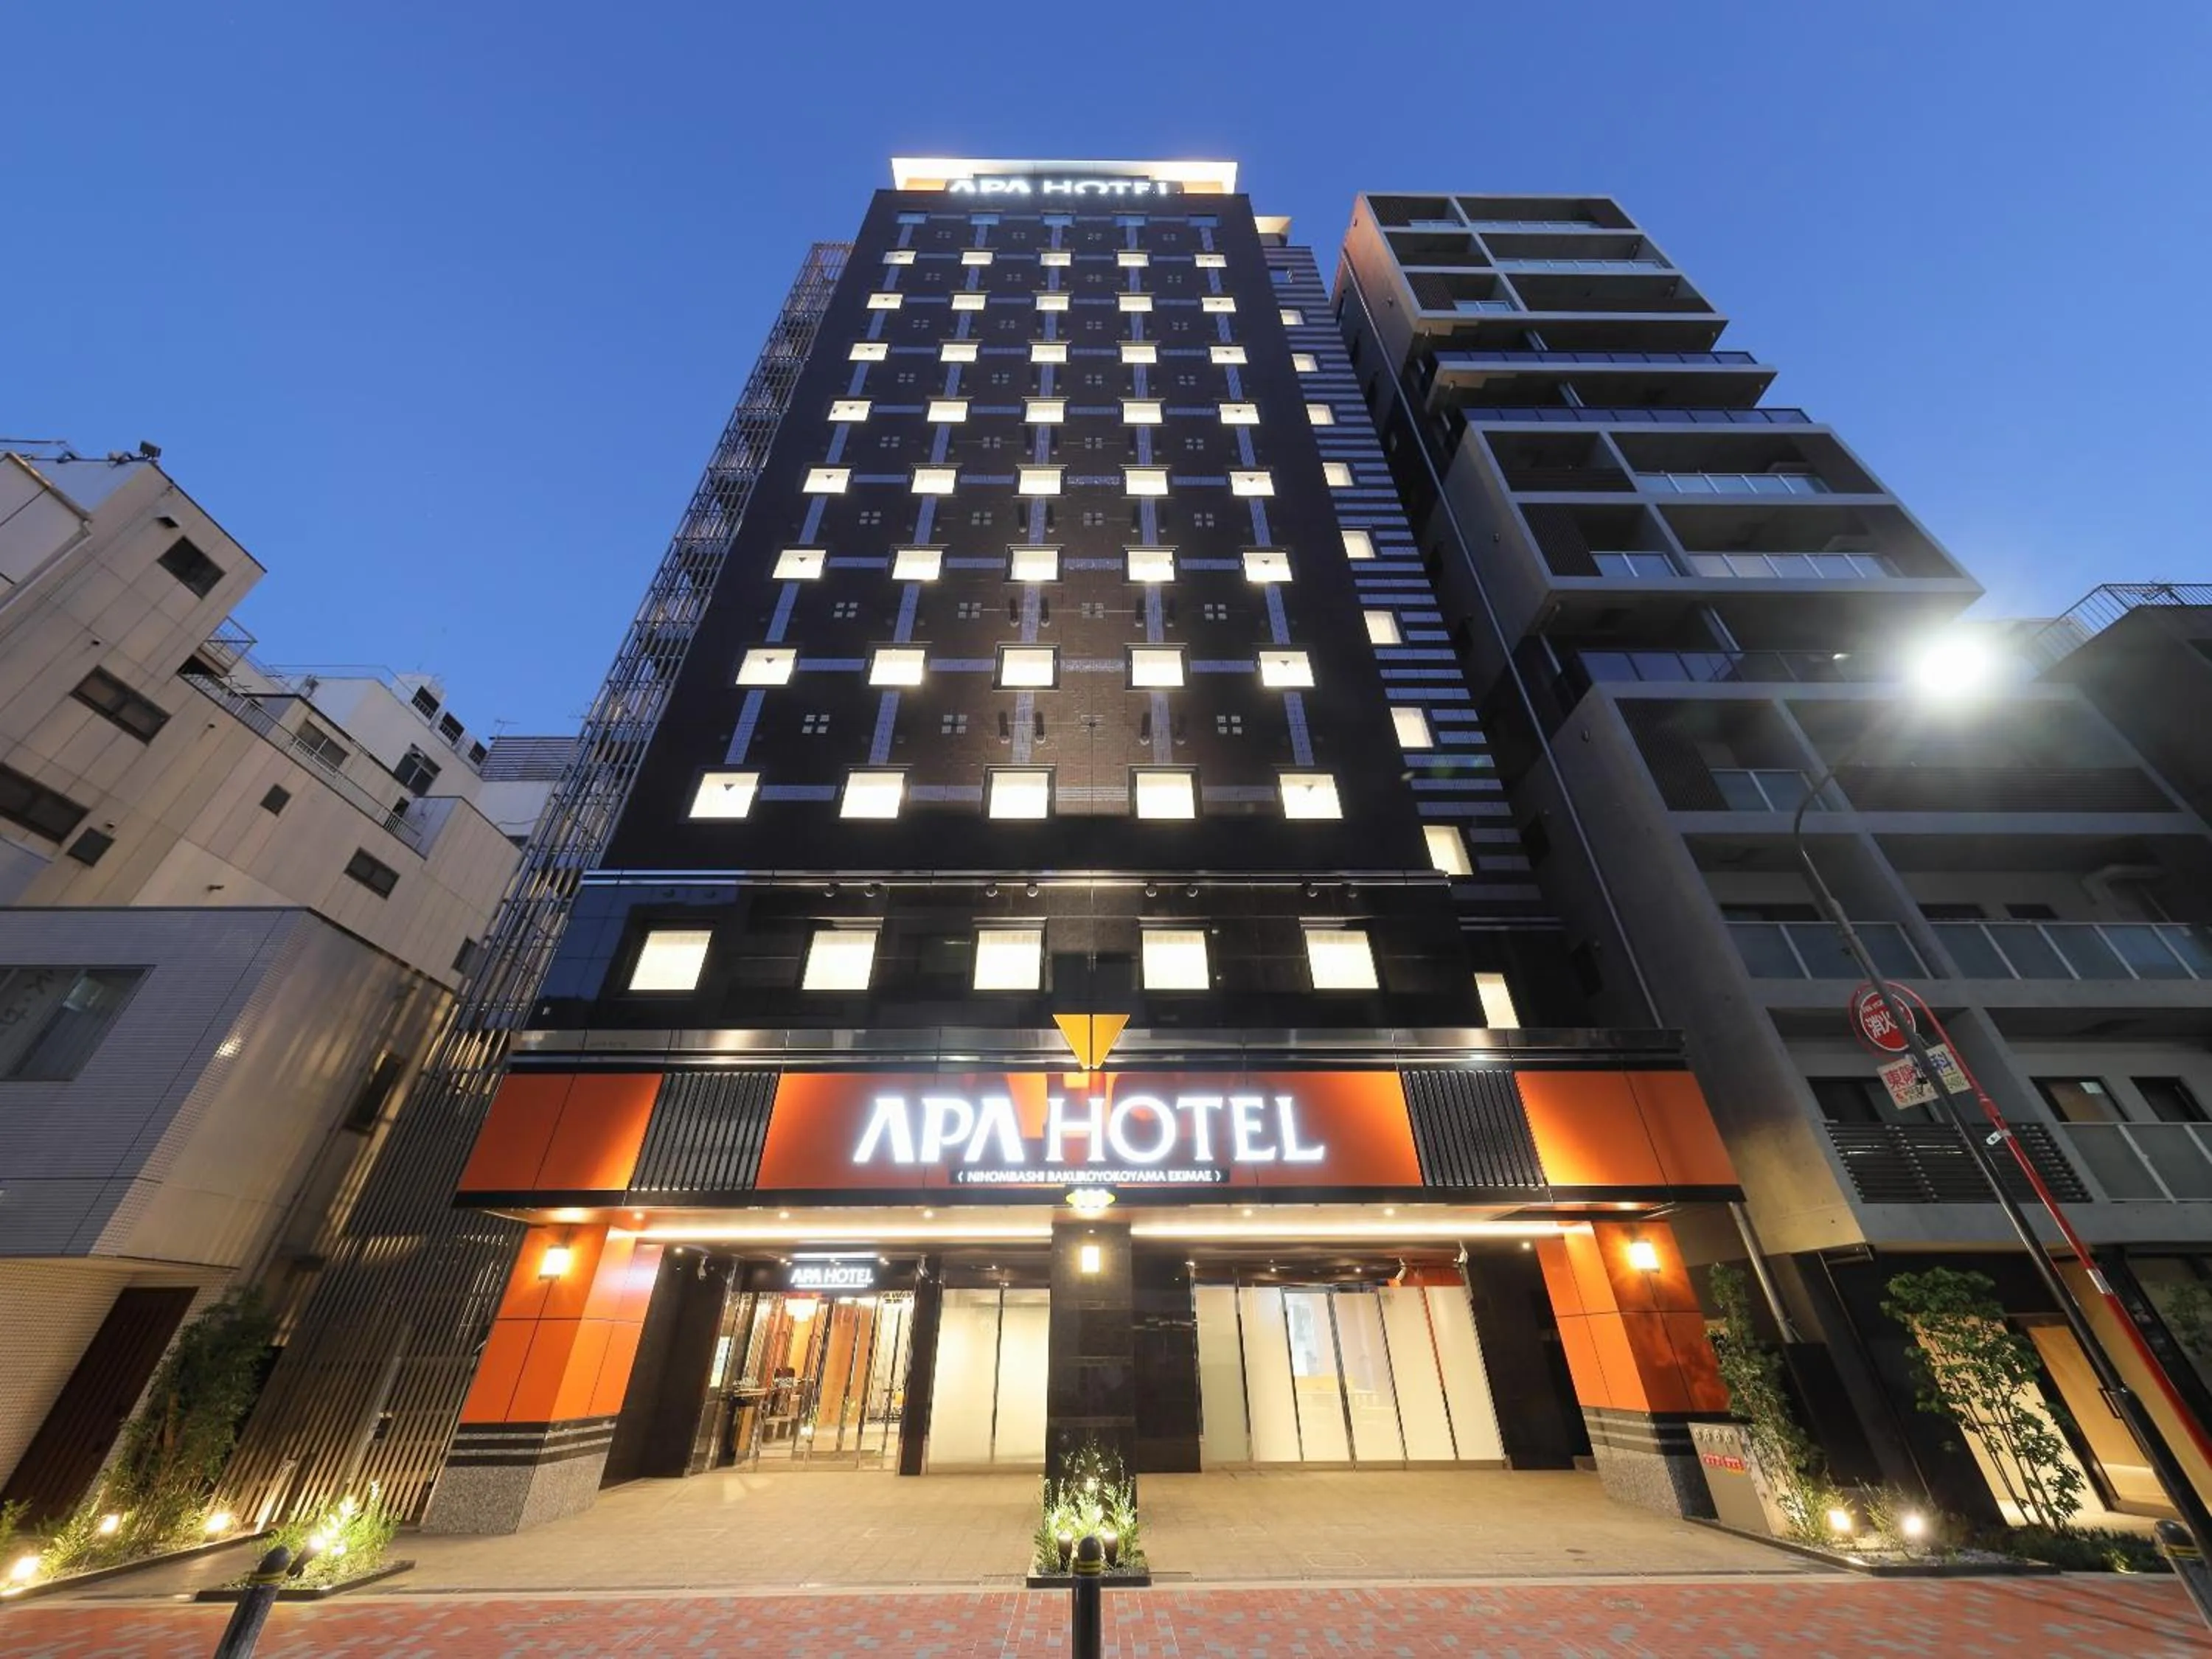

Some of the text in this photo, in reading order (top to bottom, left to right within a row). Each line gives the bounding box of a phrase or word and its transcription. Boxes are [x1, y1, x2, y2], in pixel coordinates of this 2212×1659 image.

[948, 179, 1032, 193] APA
[852, 1096, 1326, 1164] APA HOTEL
[967, 1170, 1213, 1183] NIHOMBASHI BAKUROYOKOYAMA EKIMAE
[790, 1268, 874, 1284] APA HOTEL
